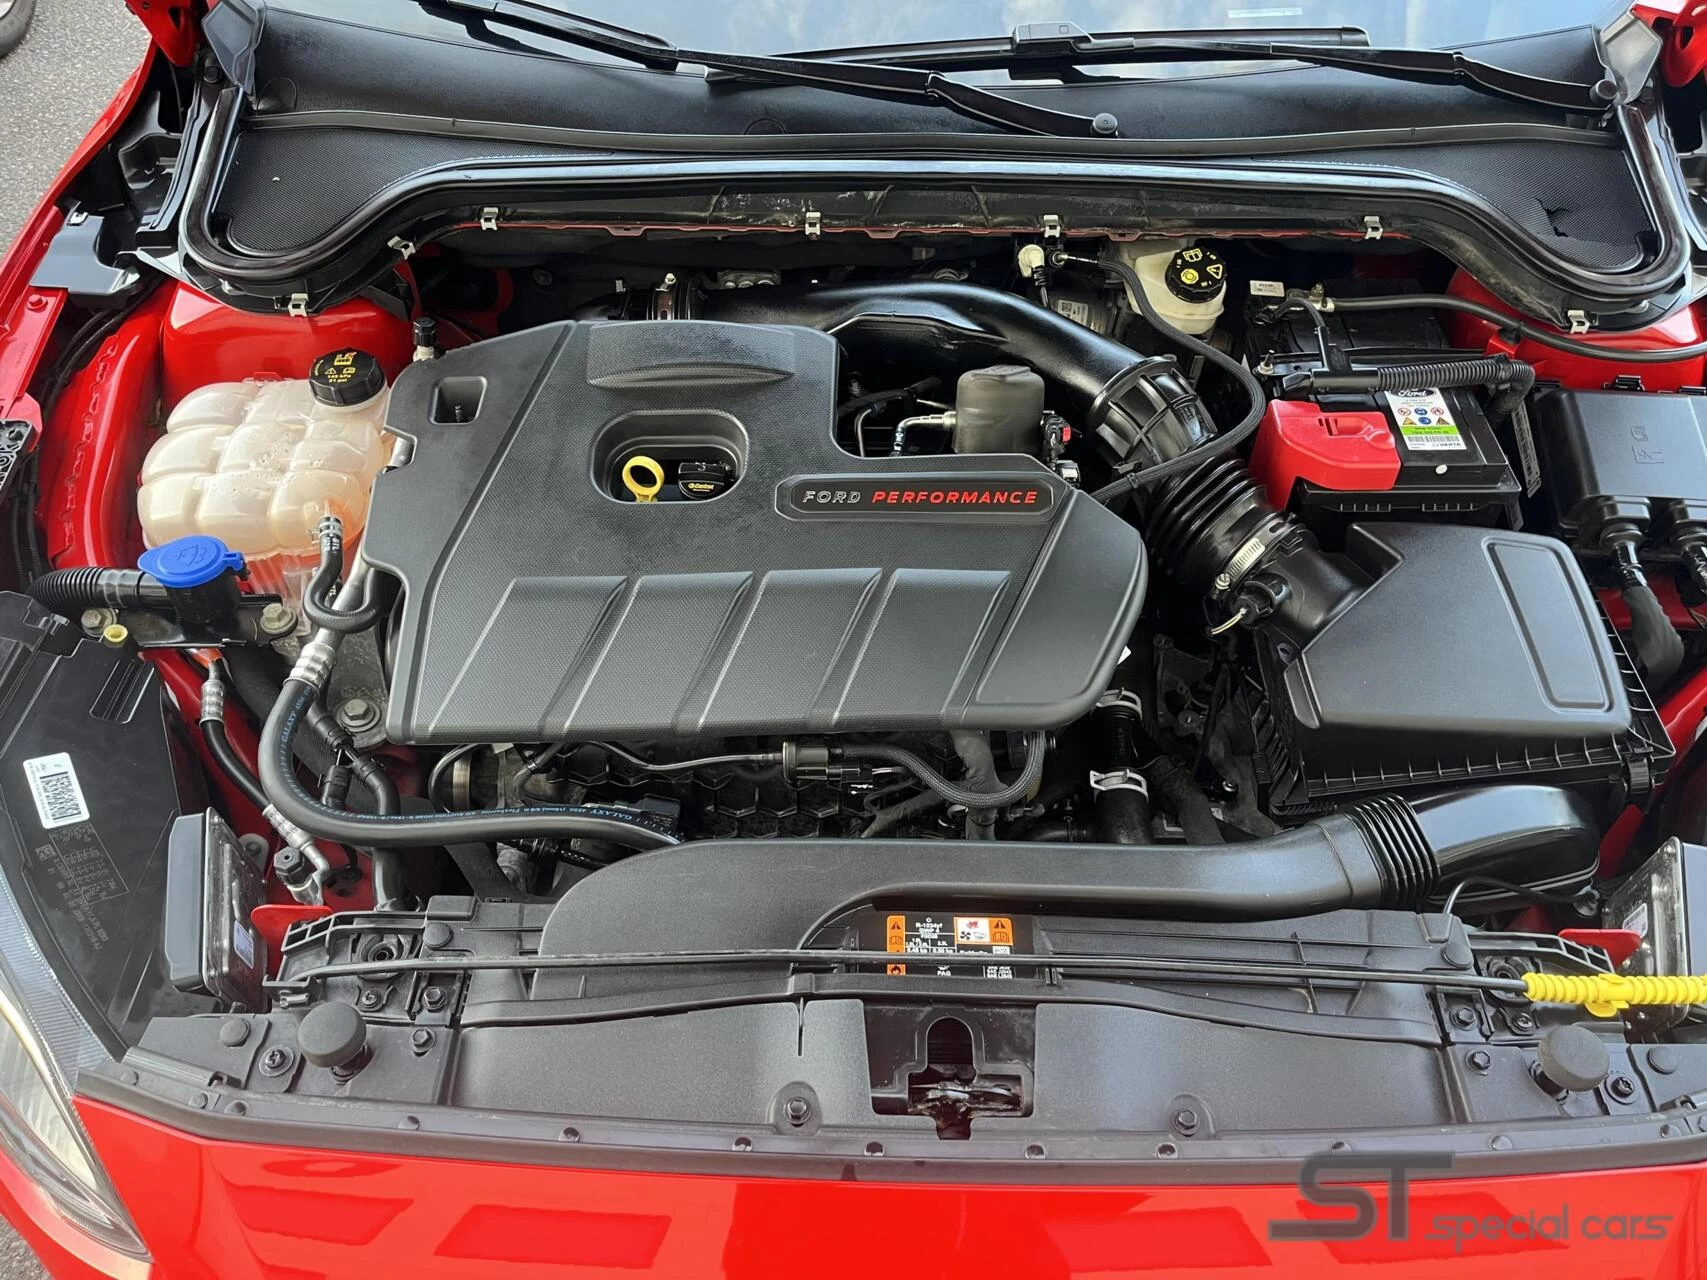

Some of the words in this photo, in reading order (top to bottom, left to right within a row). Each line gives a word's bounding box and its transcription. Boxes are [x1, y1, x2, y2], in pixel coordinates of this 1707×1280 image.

[802, 490, 862, 503] FORD
[871, 490, 1038, 504] PERFORMANCE
[281, 710, 297, 743] GALAXY
[590, 809, 633, 820] GALAXY
